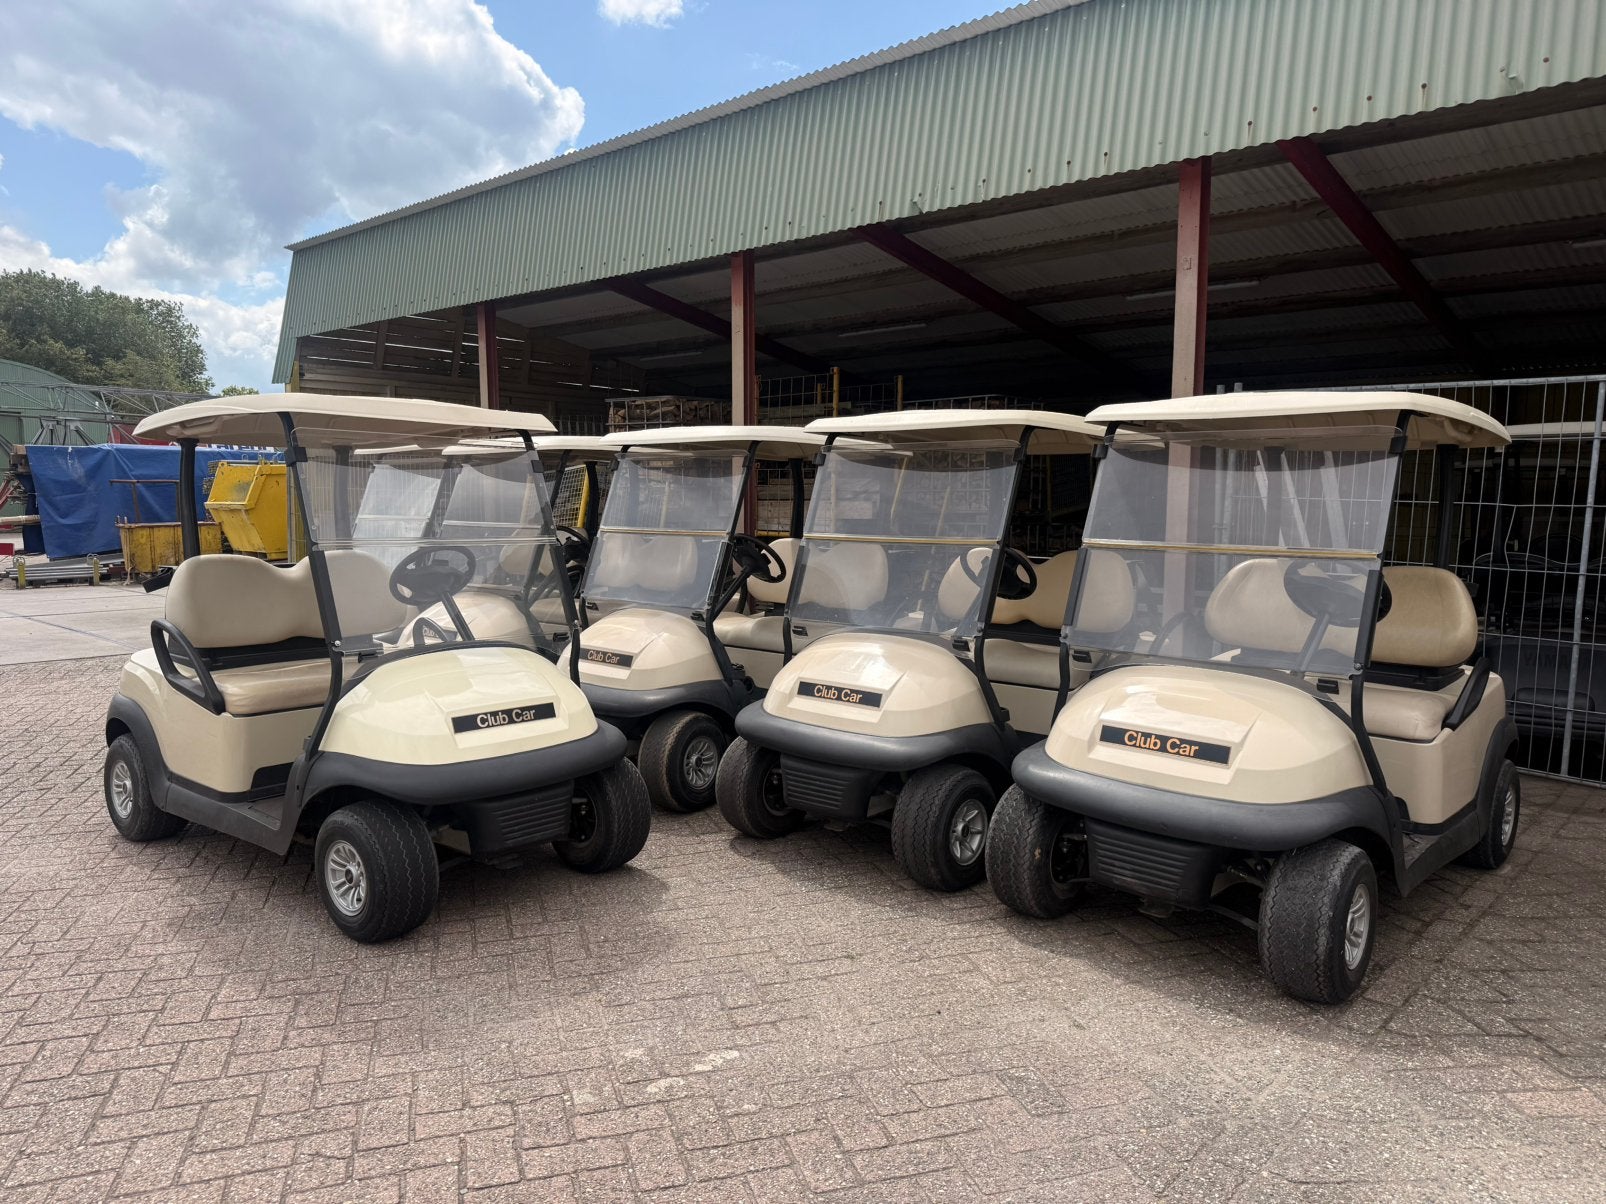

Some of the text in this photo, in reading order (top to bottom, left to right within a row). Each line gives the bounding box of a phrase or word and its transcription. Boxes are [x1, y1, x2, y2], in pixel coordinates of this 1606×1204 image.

[587, 650, 620, 664] Club Car
[814, 685, 862, 703] Club Car
[476, 709, 536, 728] Club Car
[1124, 730, 1200, 757] Club Car
